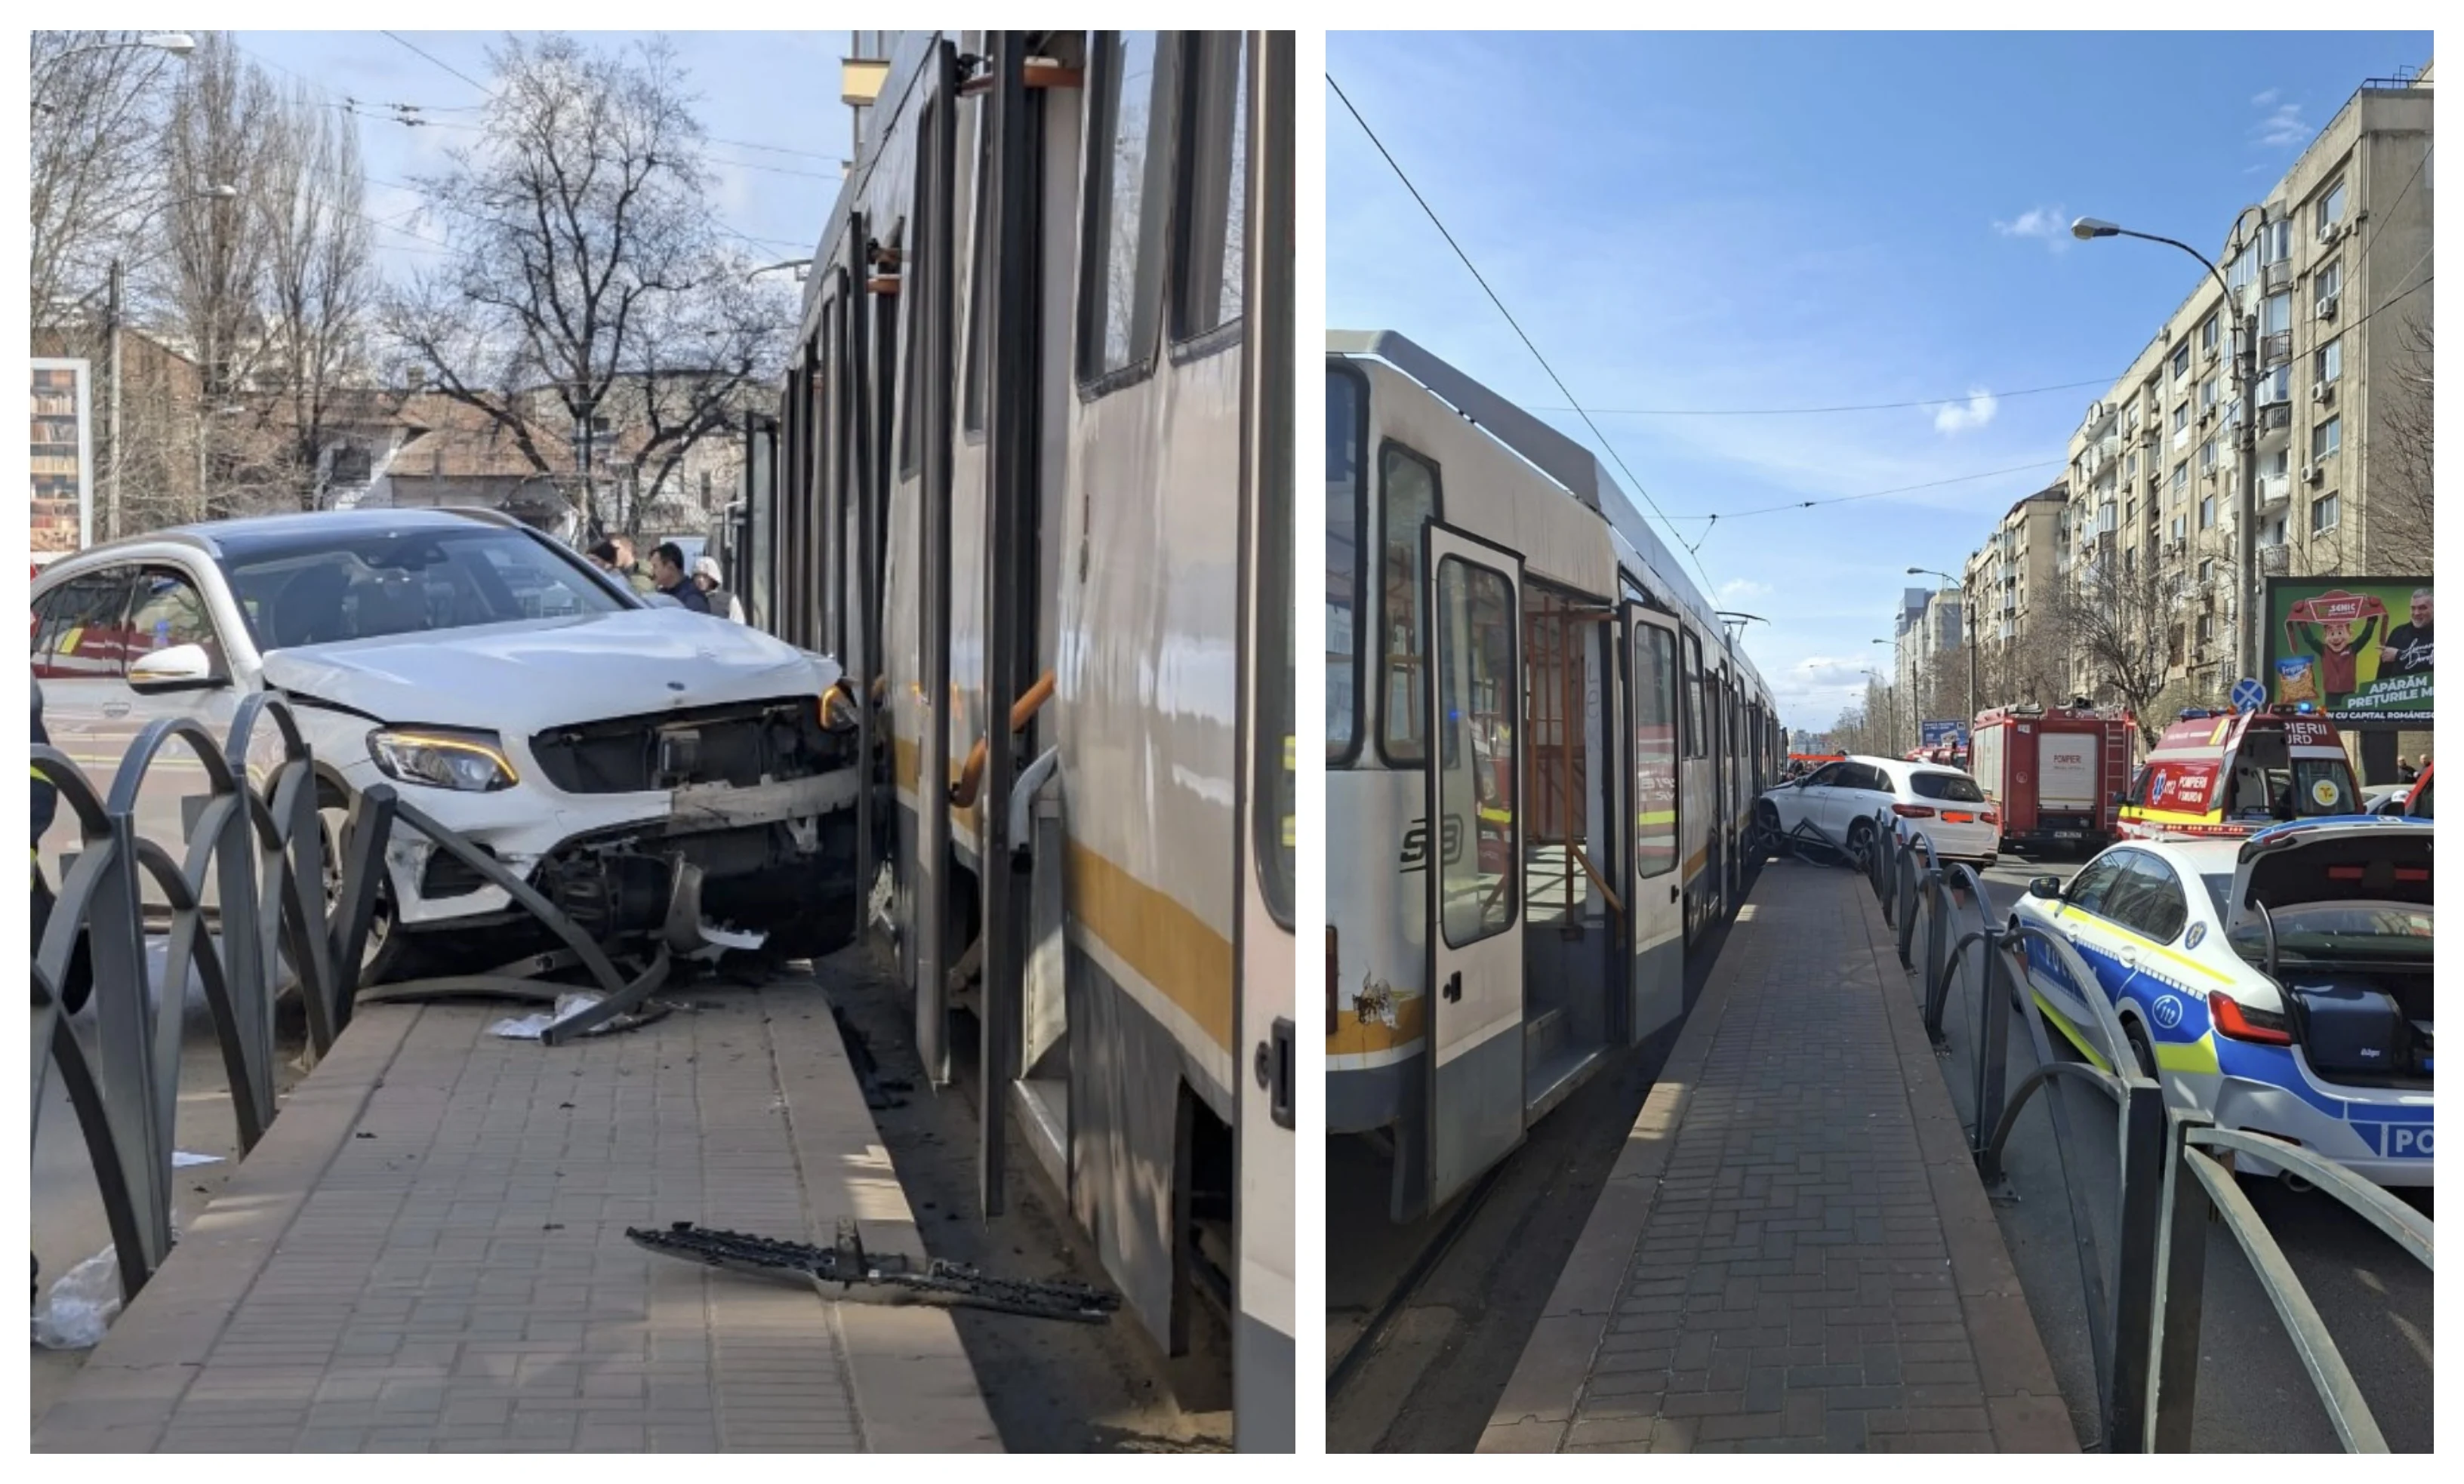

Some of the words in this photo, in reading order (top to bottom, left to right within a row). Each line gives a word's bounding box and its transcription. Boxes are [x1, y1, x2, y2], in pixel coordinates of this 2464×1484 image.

[2369, 674, 2427, 694] APĂRĂM
[2160, 1005, 2176, 1024] 112
[2396, 1129, 2434, 1153] PO
